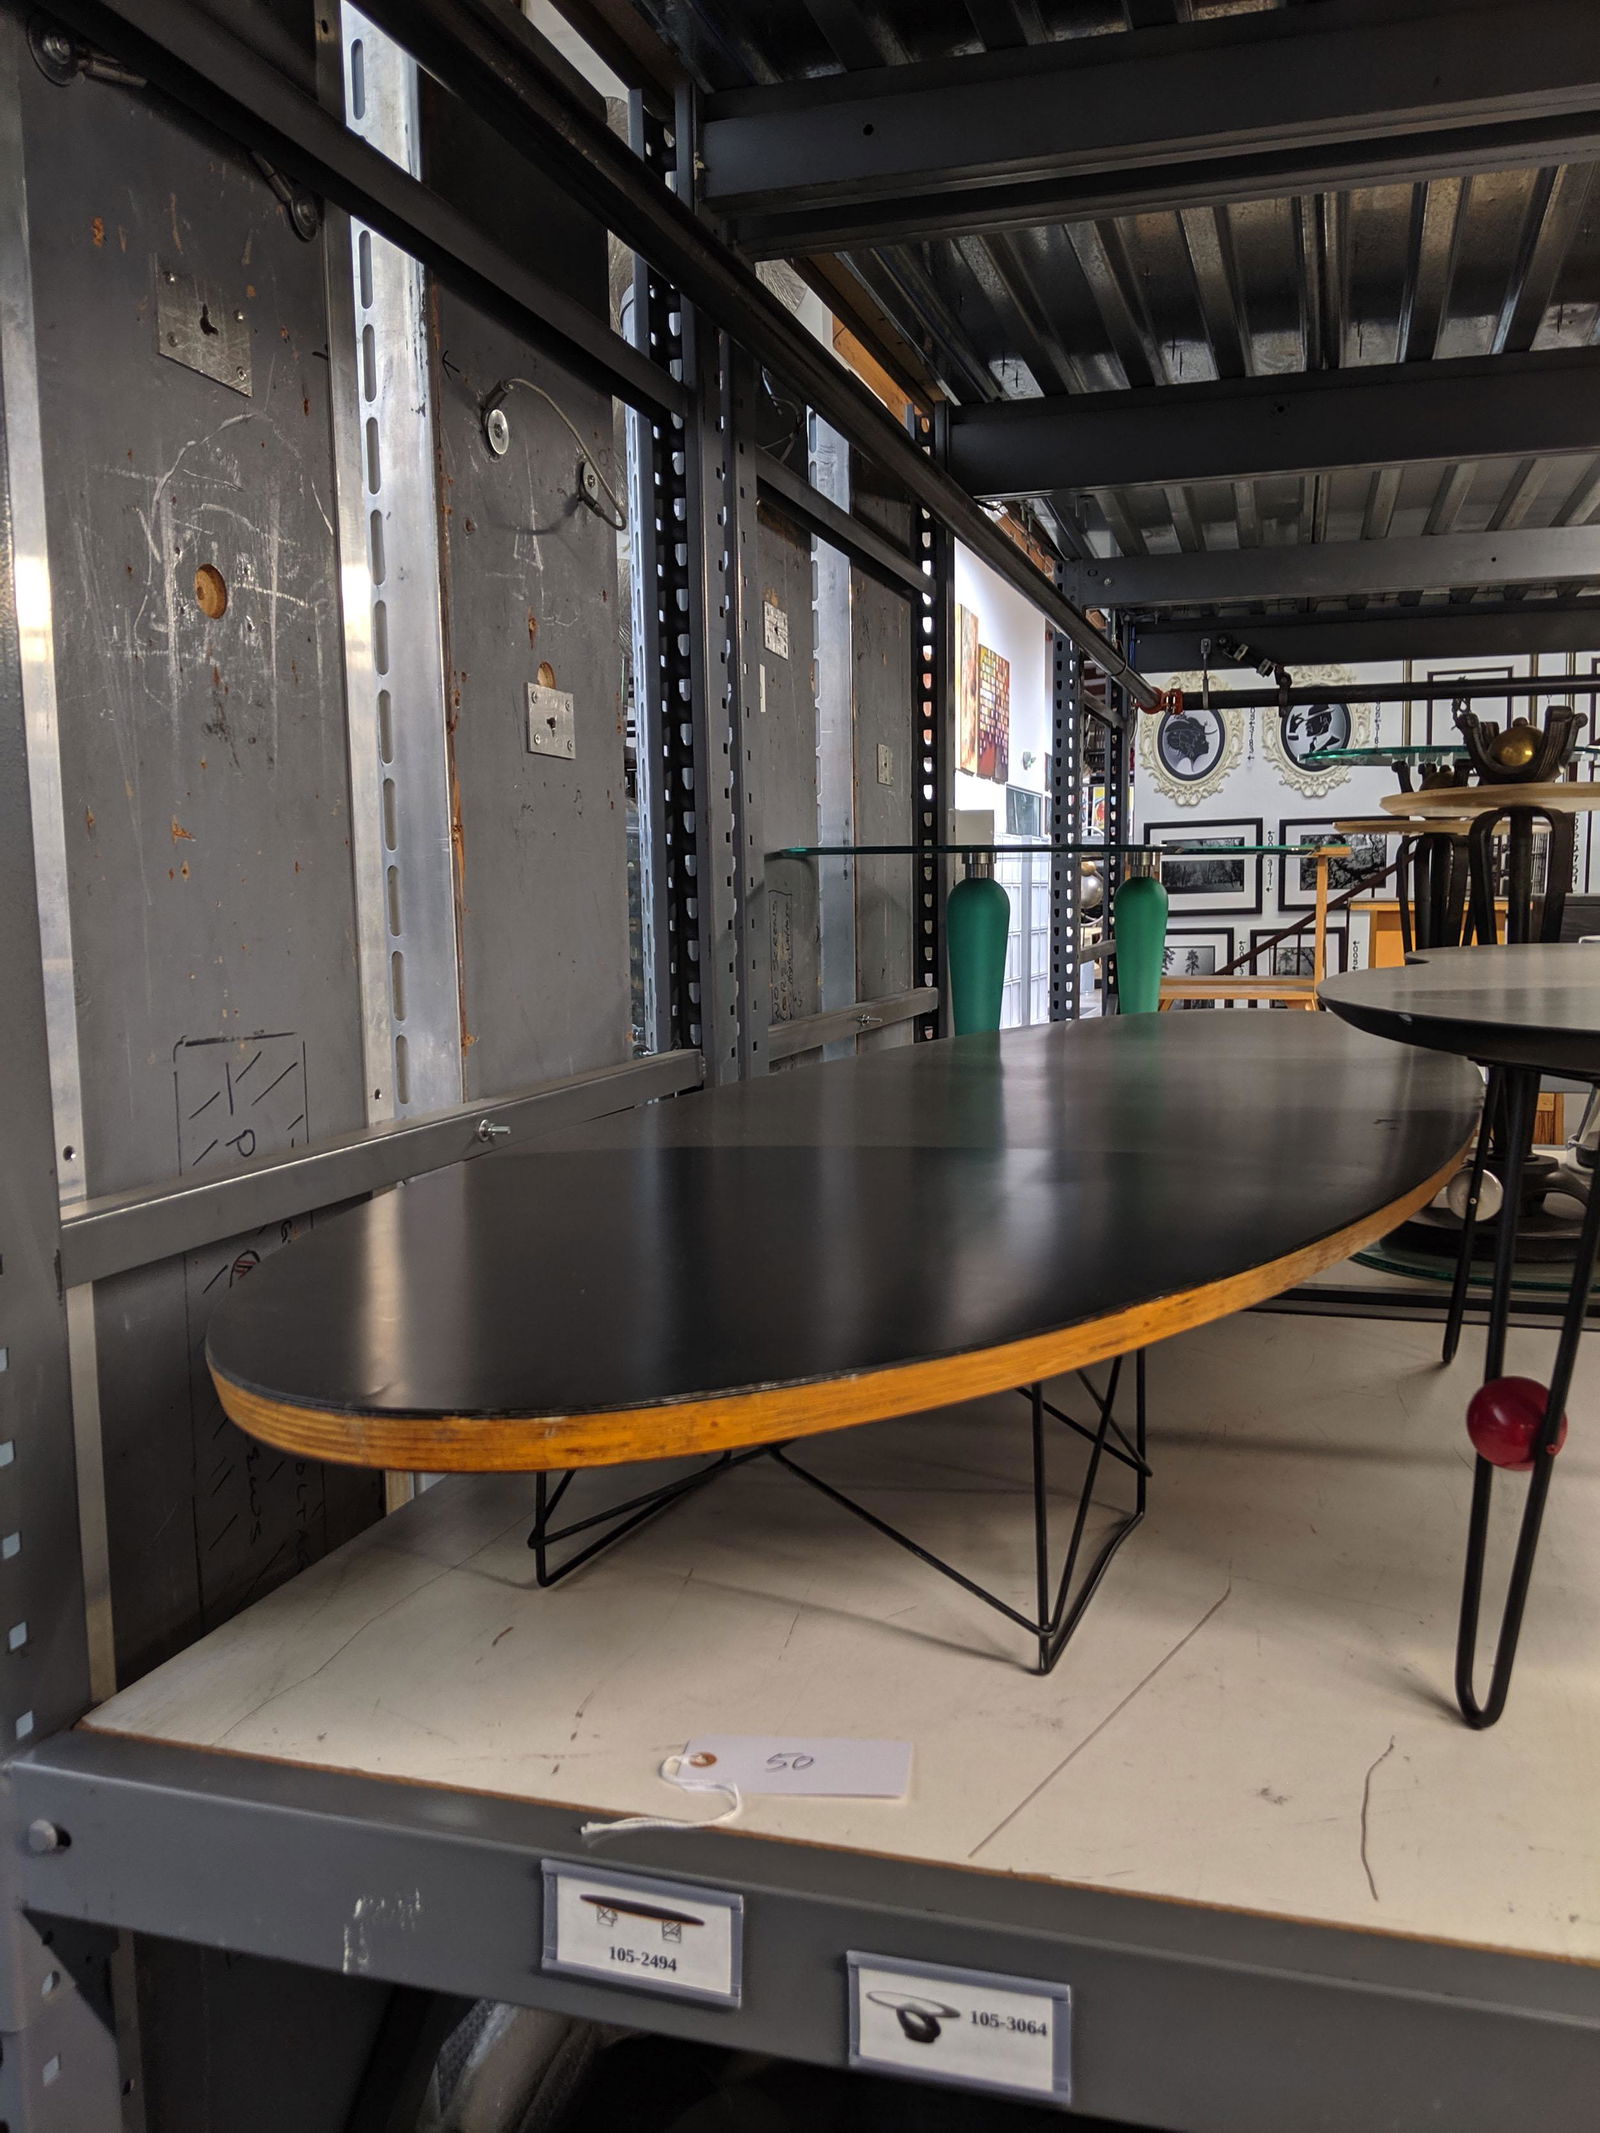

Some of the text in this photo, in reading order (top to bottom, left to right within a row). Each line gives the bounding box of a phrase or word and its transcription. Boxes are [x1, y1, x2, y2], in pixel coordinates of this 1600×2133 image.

[765, 1751, 815, 1774] 50
[609, 1945, 677, 1973] 105-2494
[970, 2009, 1048, 2038] 105-3064
